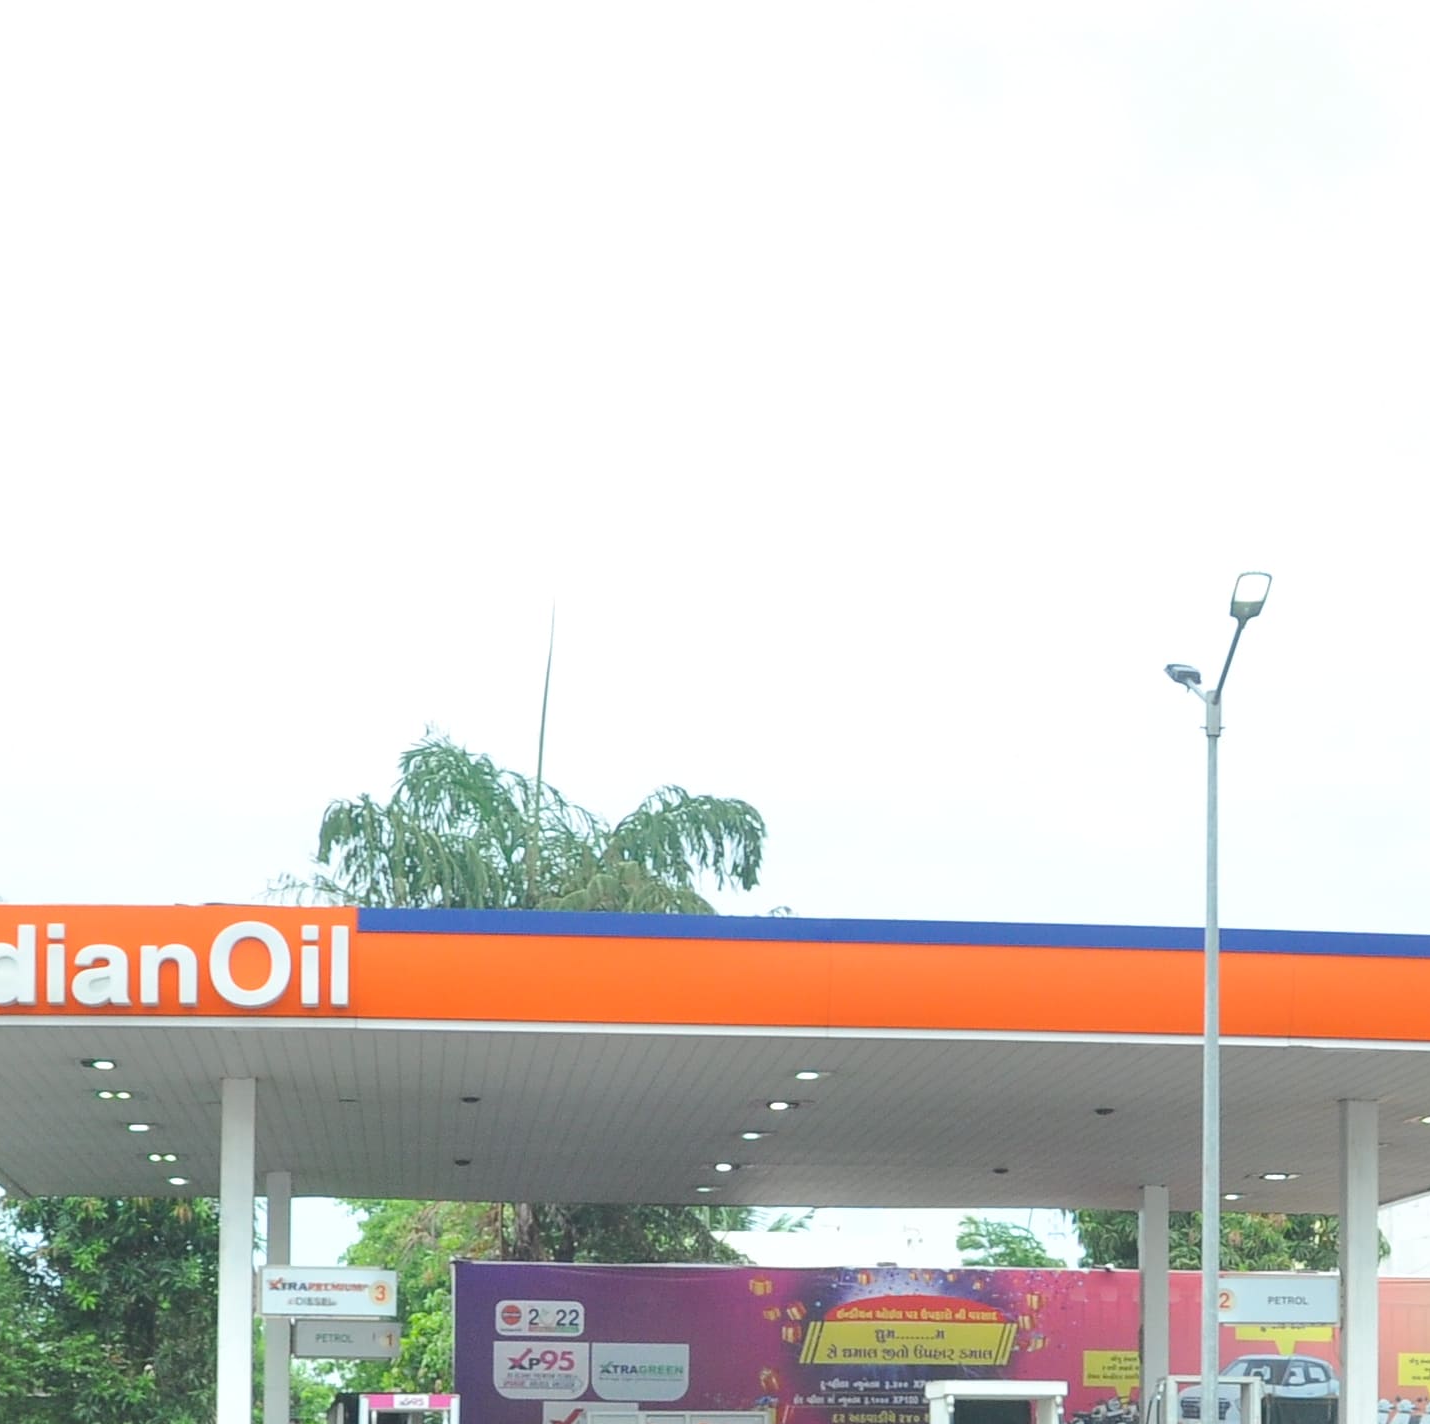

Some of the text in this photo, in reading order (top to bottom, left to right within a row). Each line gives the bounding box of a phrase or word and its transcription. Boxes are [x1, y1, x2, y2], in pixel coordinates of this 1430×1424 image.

[374, 1284, 386, 1302] 3
[1219, 1292, 1309, 1309] 2 PETROL
[315, 1333, 353, 1344] PETROL
[599, 1361, 684, 1375] XTRAGREEN
